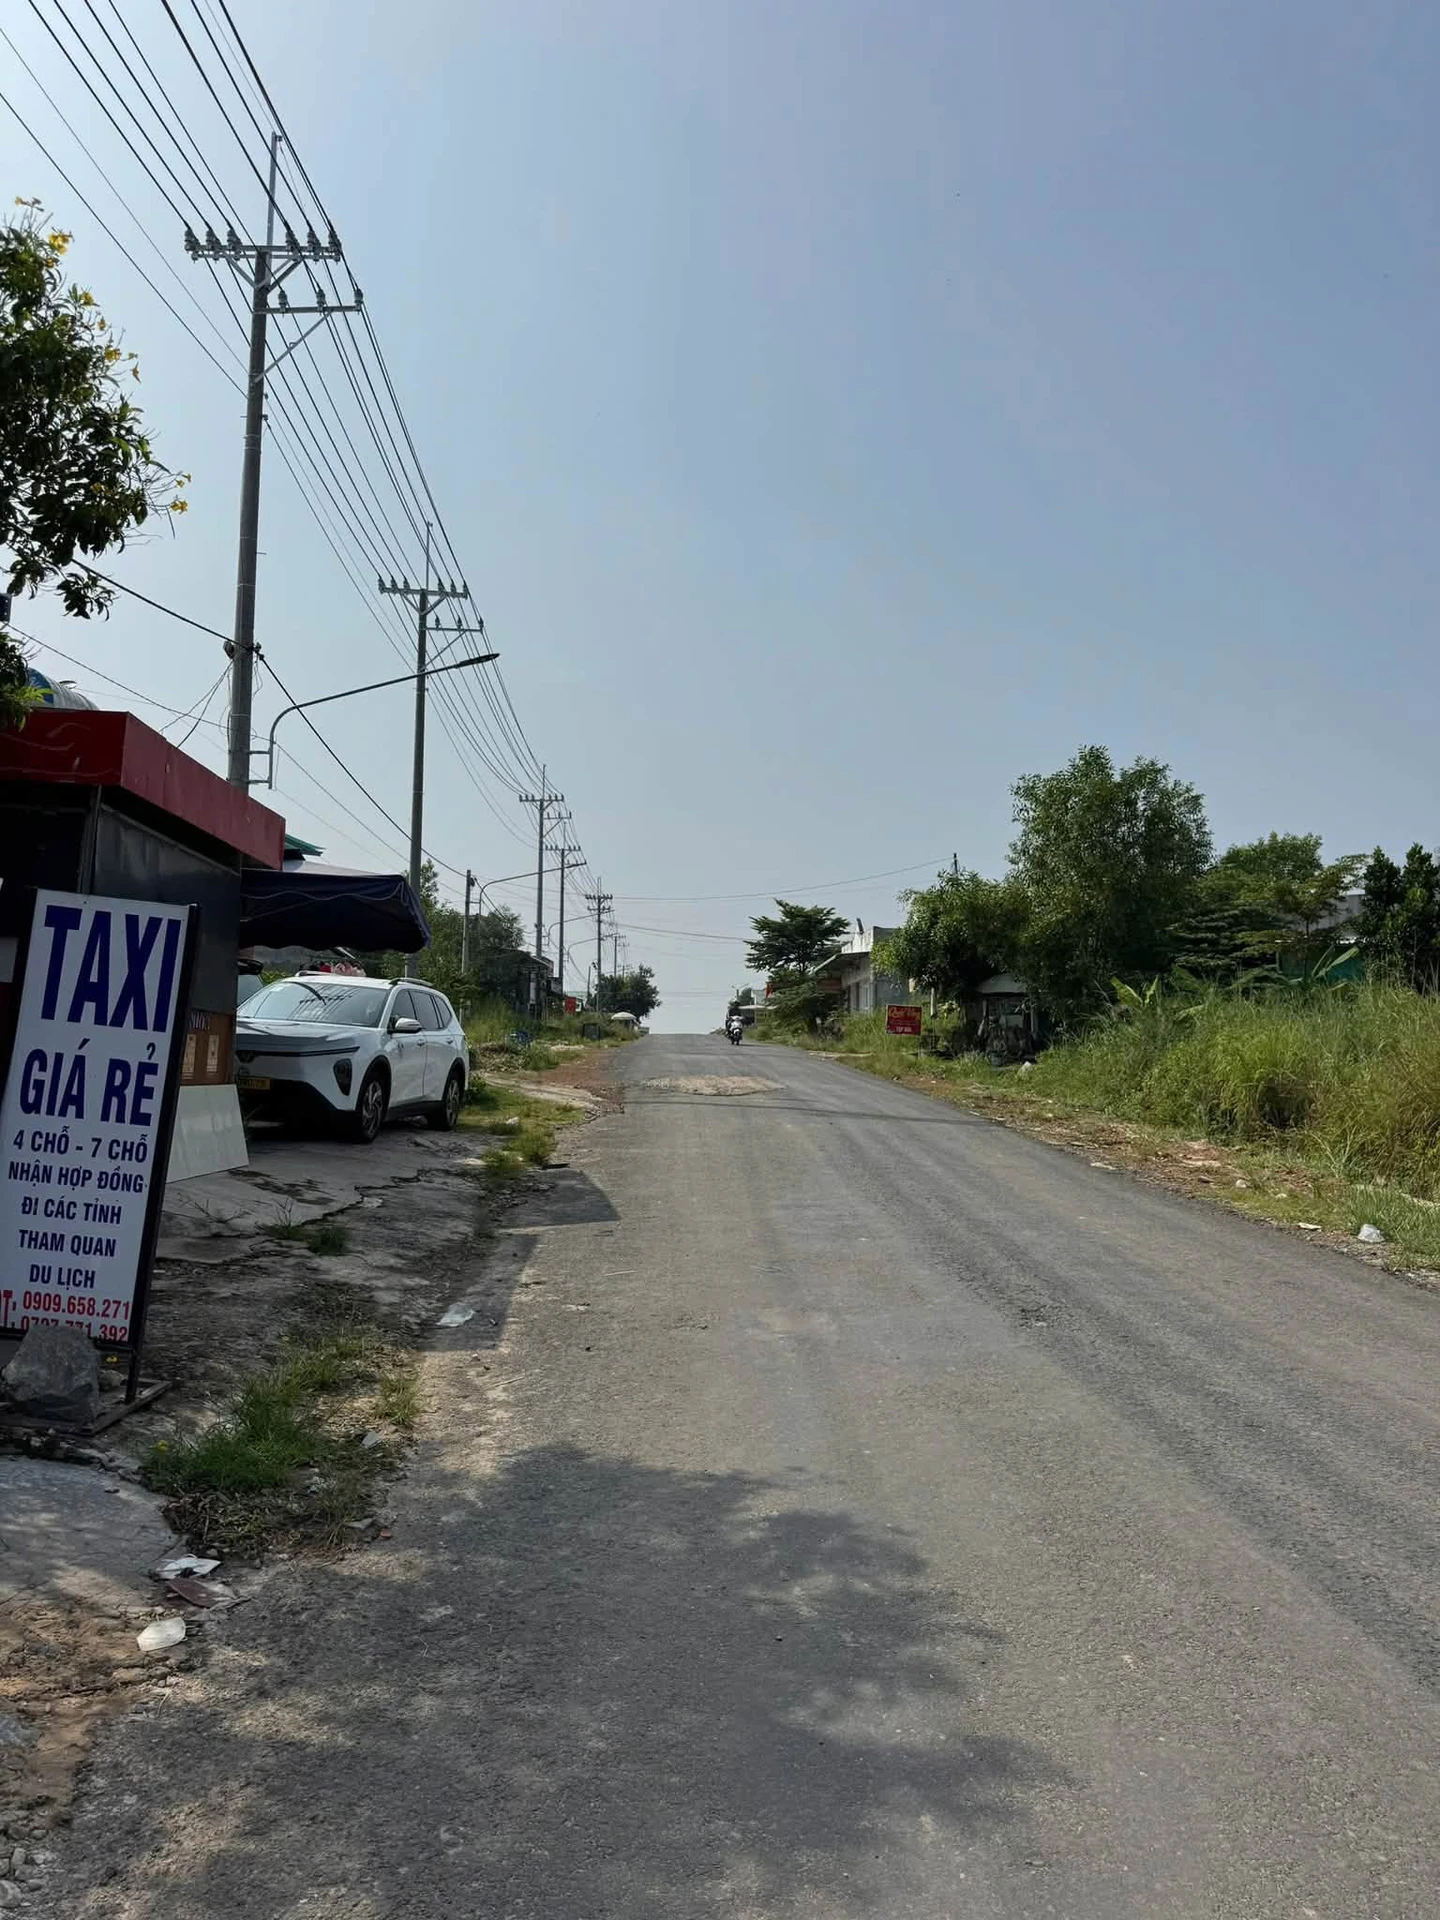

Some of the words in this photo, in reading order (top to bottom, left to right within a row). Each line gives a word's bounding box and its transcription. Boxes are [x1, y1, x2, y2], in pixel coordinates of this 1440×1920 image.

[41, 905, 181, 1033] TAXI
[20, 1038, 90, 1119] GIÁ
[100, 1042, 158, 1126] RẺ
[13, 1129, 25, 1150] 4
[31, 1125, 70, 1155] CHỖ
[91, 1137, 102, 1158] 7
[108, 1133, 148, 1163] CHỖ
[8, 1159, 53, 1187] NHẬN
[57, 1166, 93, 1191] HỢP
[97, 1165, 144, 1193] ĐỒNG
[21, 1196, 39, 1216] ĐI
[43, 1195, 77, 1220] CÁC
[83, 1197, 122, 1225] TỈNH
[19, 1229, 65, 1252] THAM
[70, 1234, 116, 1257] QUAN
[29, 1263, 52, 1285] DU
[57, 1267, 96, 1290] LỊCH
[23, 1290, 130, 1320] 0909.658.271
